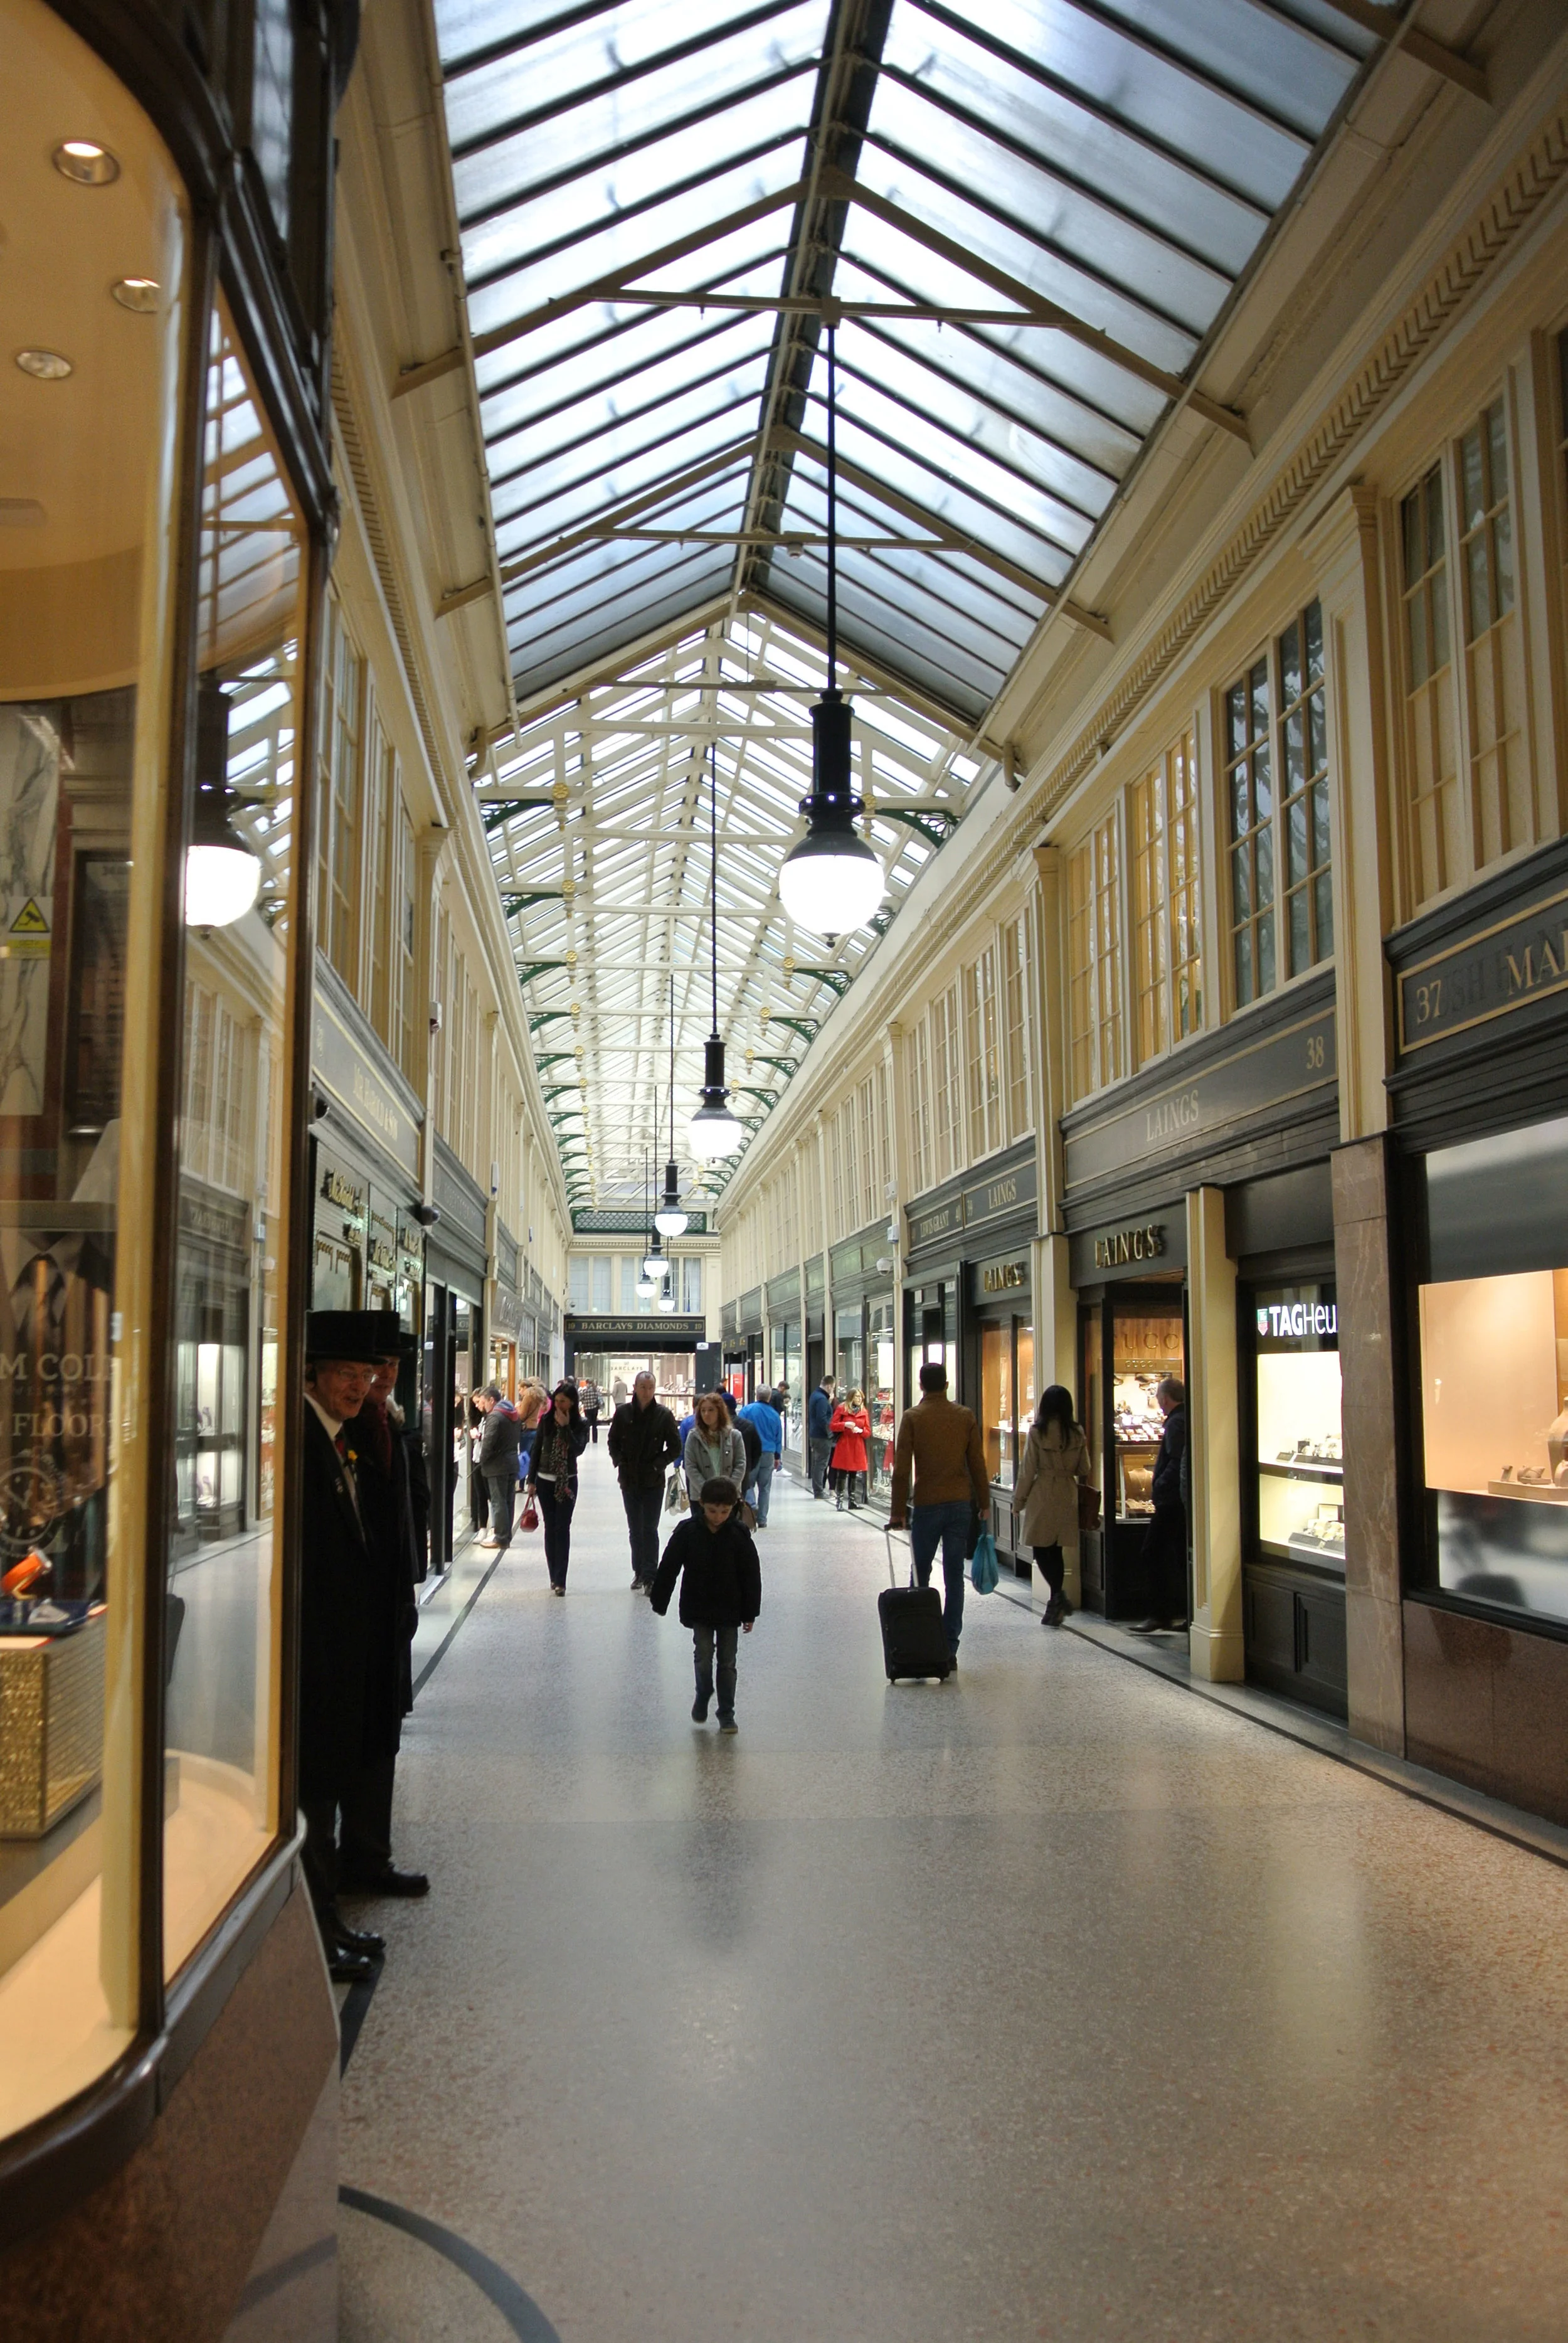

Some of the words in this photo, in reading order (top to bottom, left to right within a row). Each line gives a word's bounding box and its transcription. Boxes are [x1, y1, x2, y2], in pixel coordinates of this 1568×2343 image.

[1416, 979, 1441, 1025] 37
[1146, 1090, 1199, 1142] LAINGS
[1306, 1036, 1325, 1070] 38
[988, 1177, 1017, 1210] LAINGS
[1095, 1224, 1157, 1268] LAINGS
[983, 1261, 1025, 1293] LAINGS
[581, 1322, 633, 1330] BARCLAYS
[637, 1322, 689, 1330] DIAMONDS
[11, 1413, 105, 1437] FLOOR
